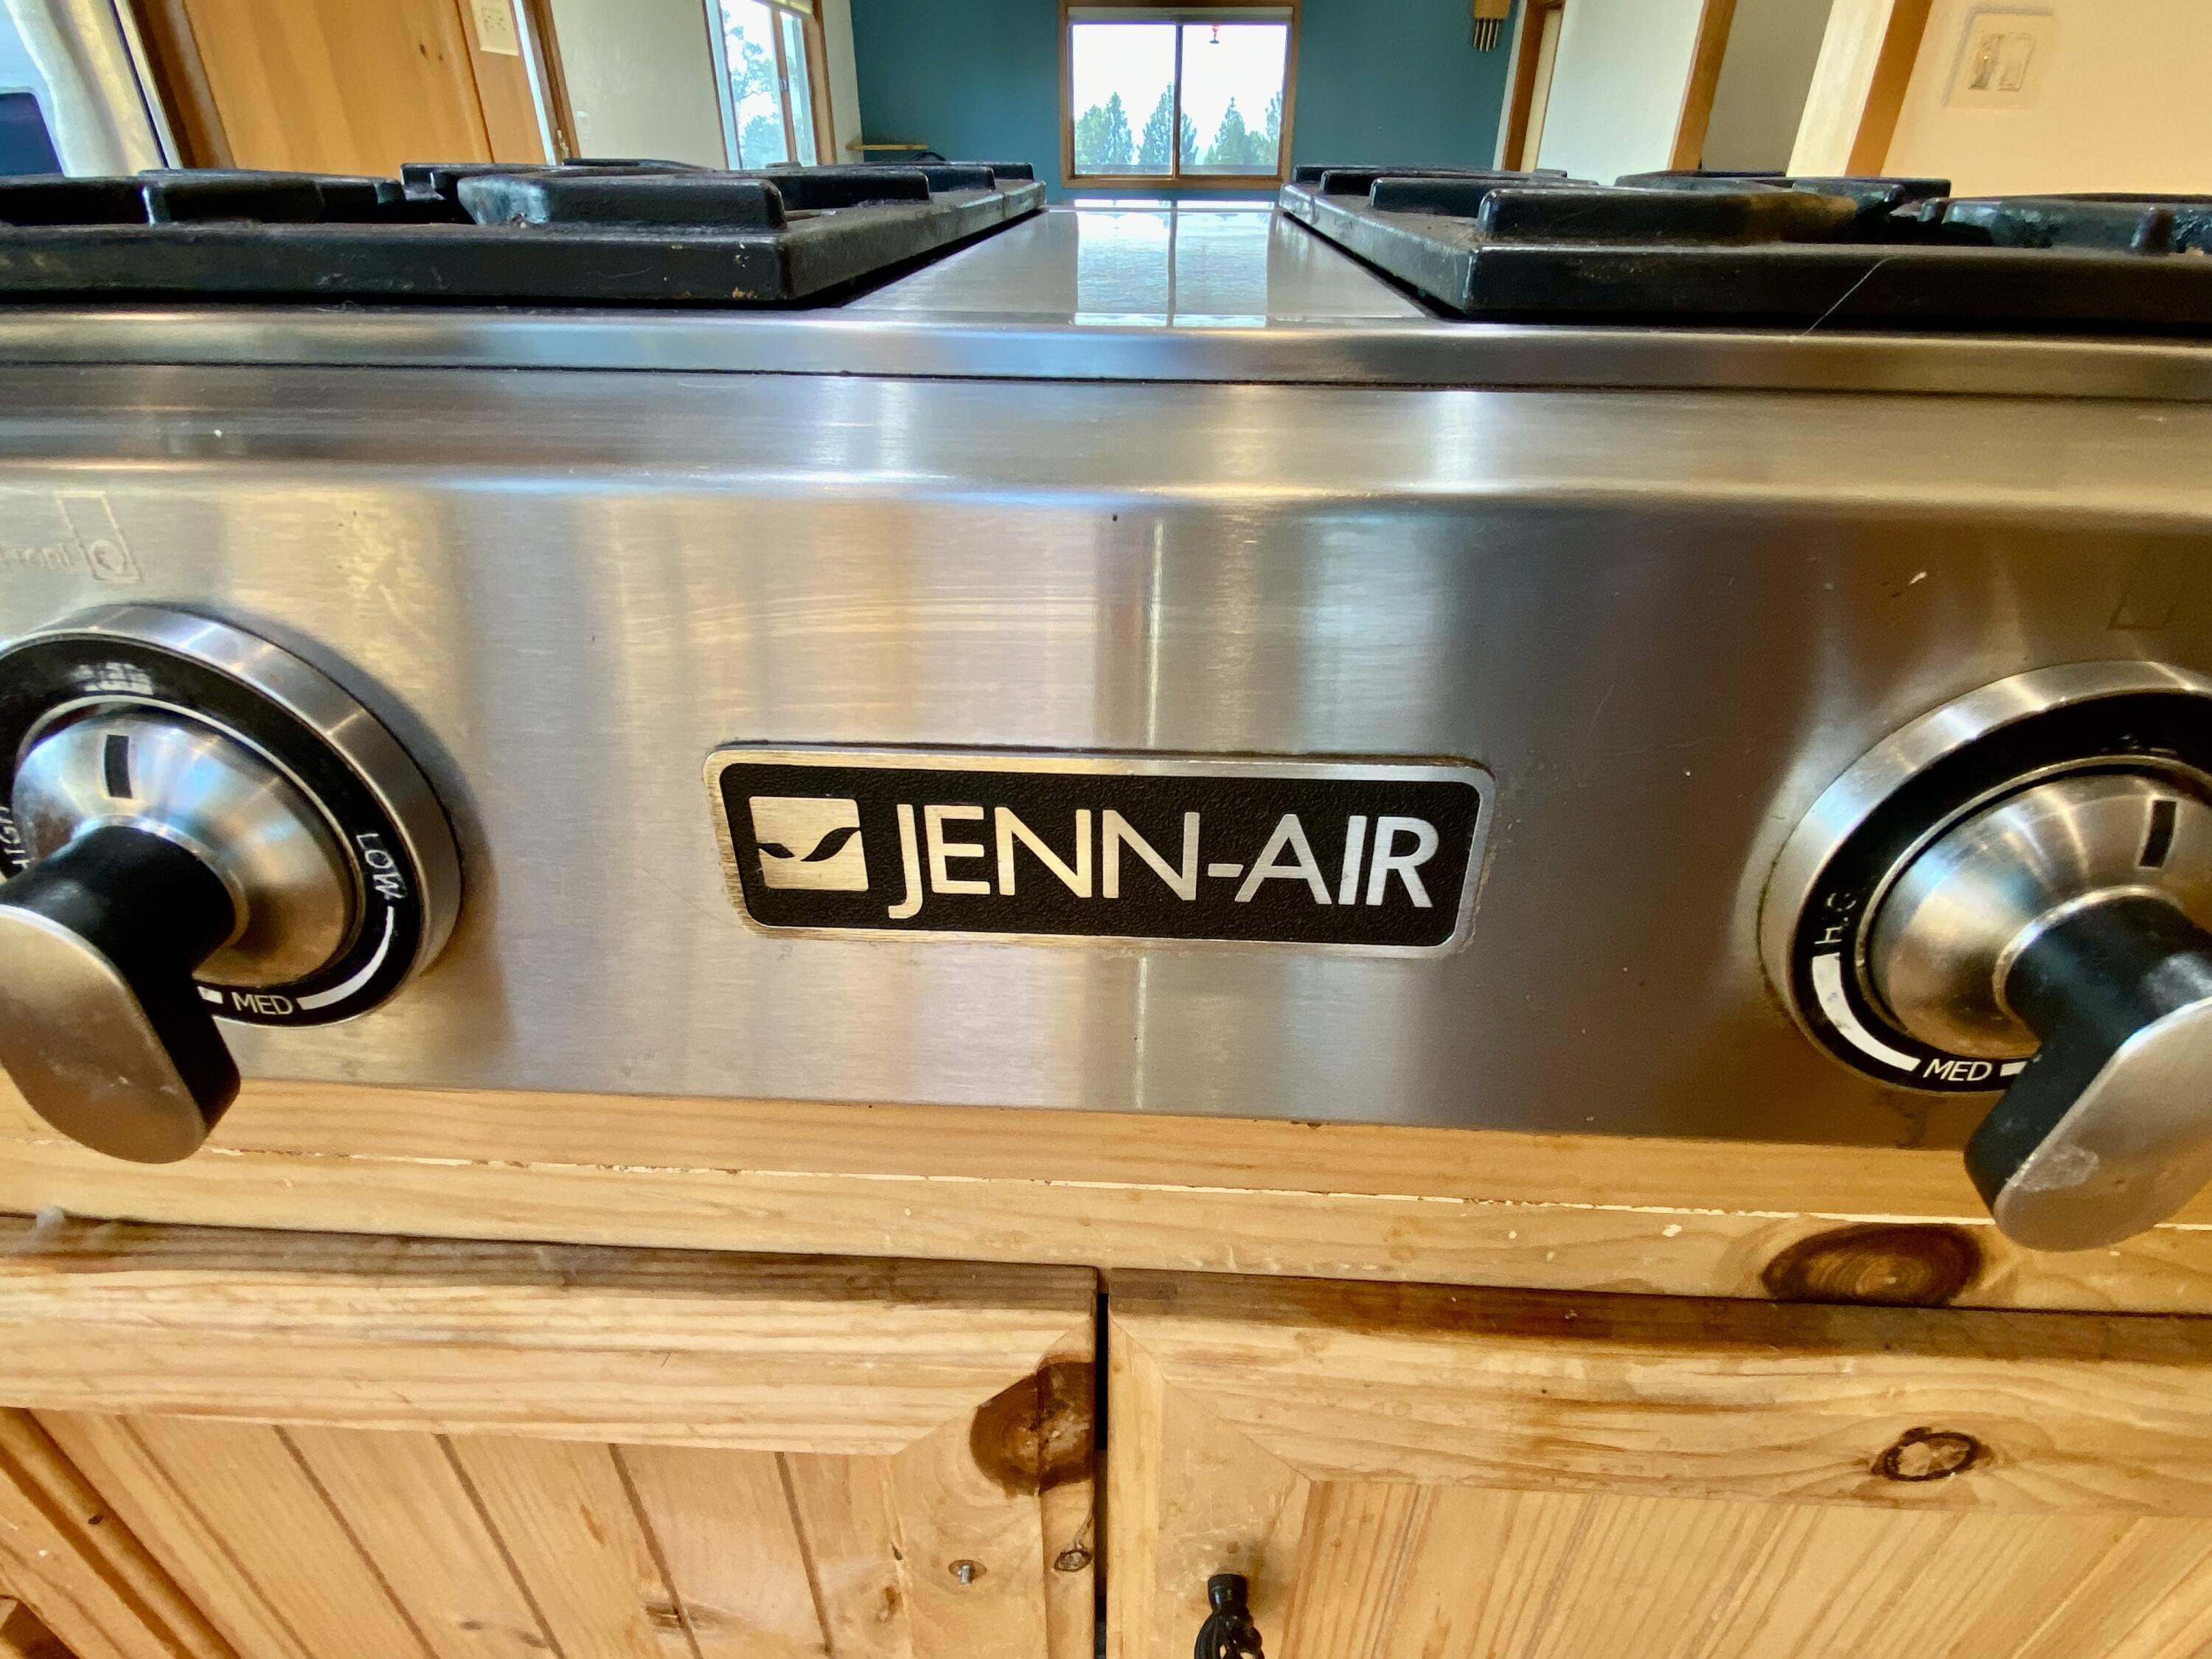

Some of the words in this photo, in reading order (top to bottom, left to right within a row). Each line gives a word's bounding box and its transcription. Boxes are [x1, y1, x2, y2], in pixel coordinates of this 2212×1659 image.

[356, 833, 407, 899] LOW
[887, 803, 1441, 919] JENN-AIR
[231, 992, 293, 1015] MED
[1922, 1058, 1993, 1082] MED
